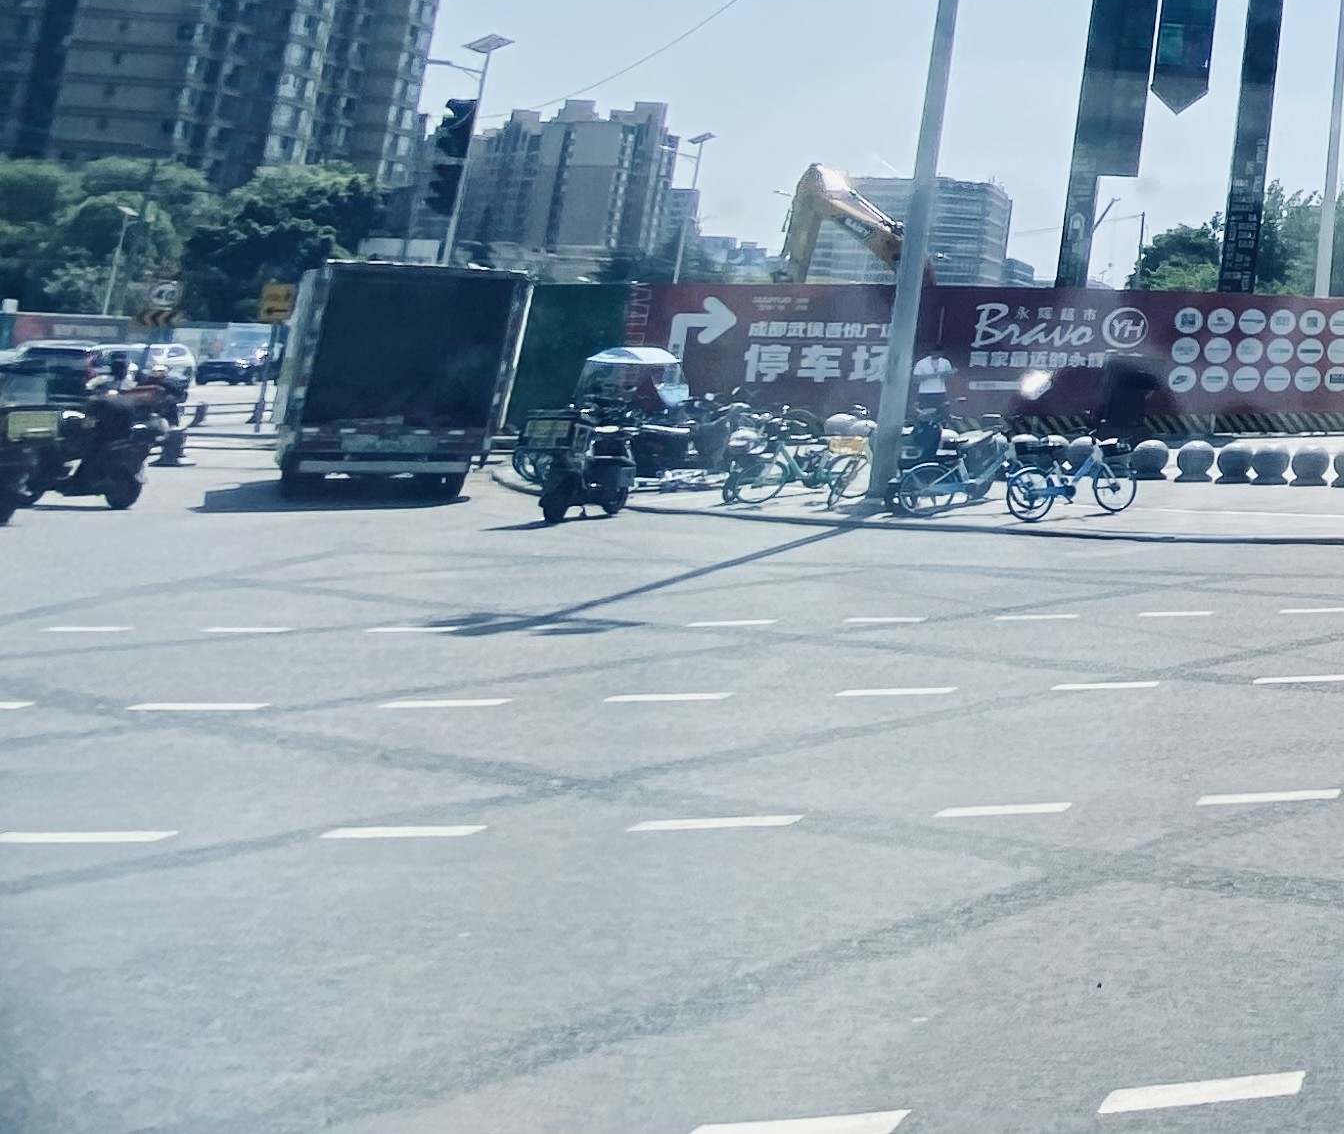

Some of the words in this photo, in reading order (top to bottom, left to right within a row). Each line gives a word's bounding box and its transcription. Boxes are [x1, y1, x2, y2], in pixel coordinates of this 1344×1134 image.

[971, 303, 1094, 348] Bravo
[1111, 319, 1145, 339] YH
[744, 344, 890, 383] 停车场
